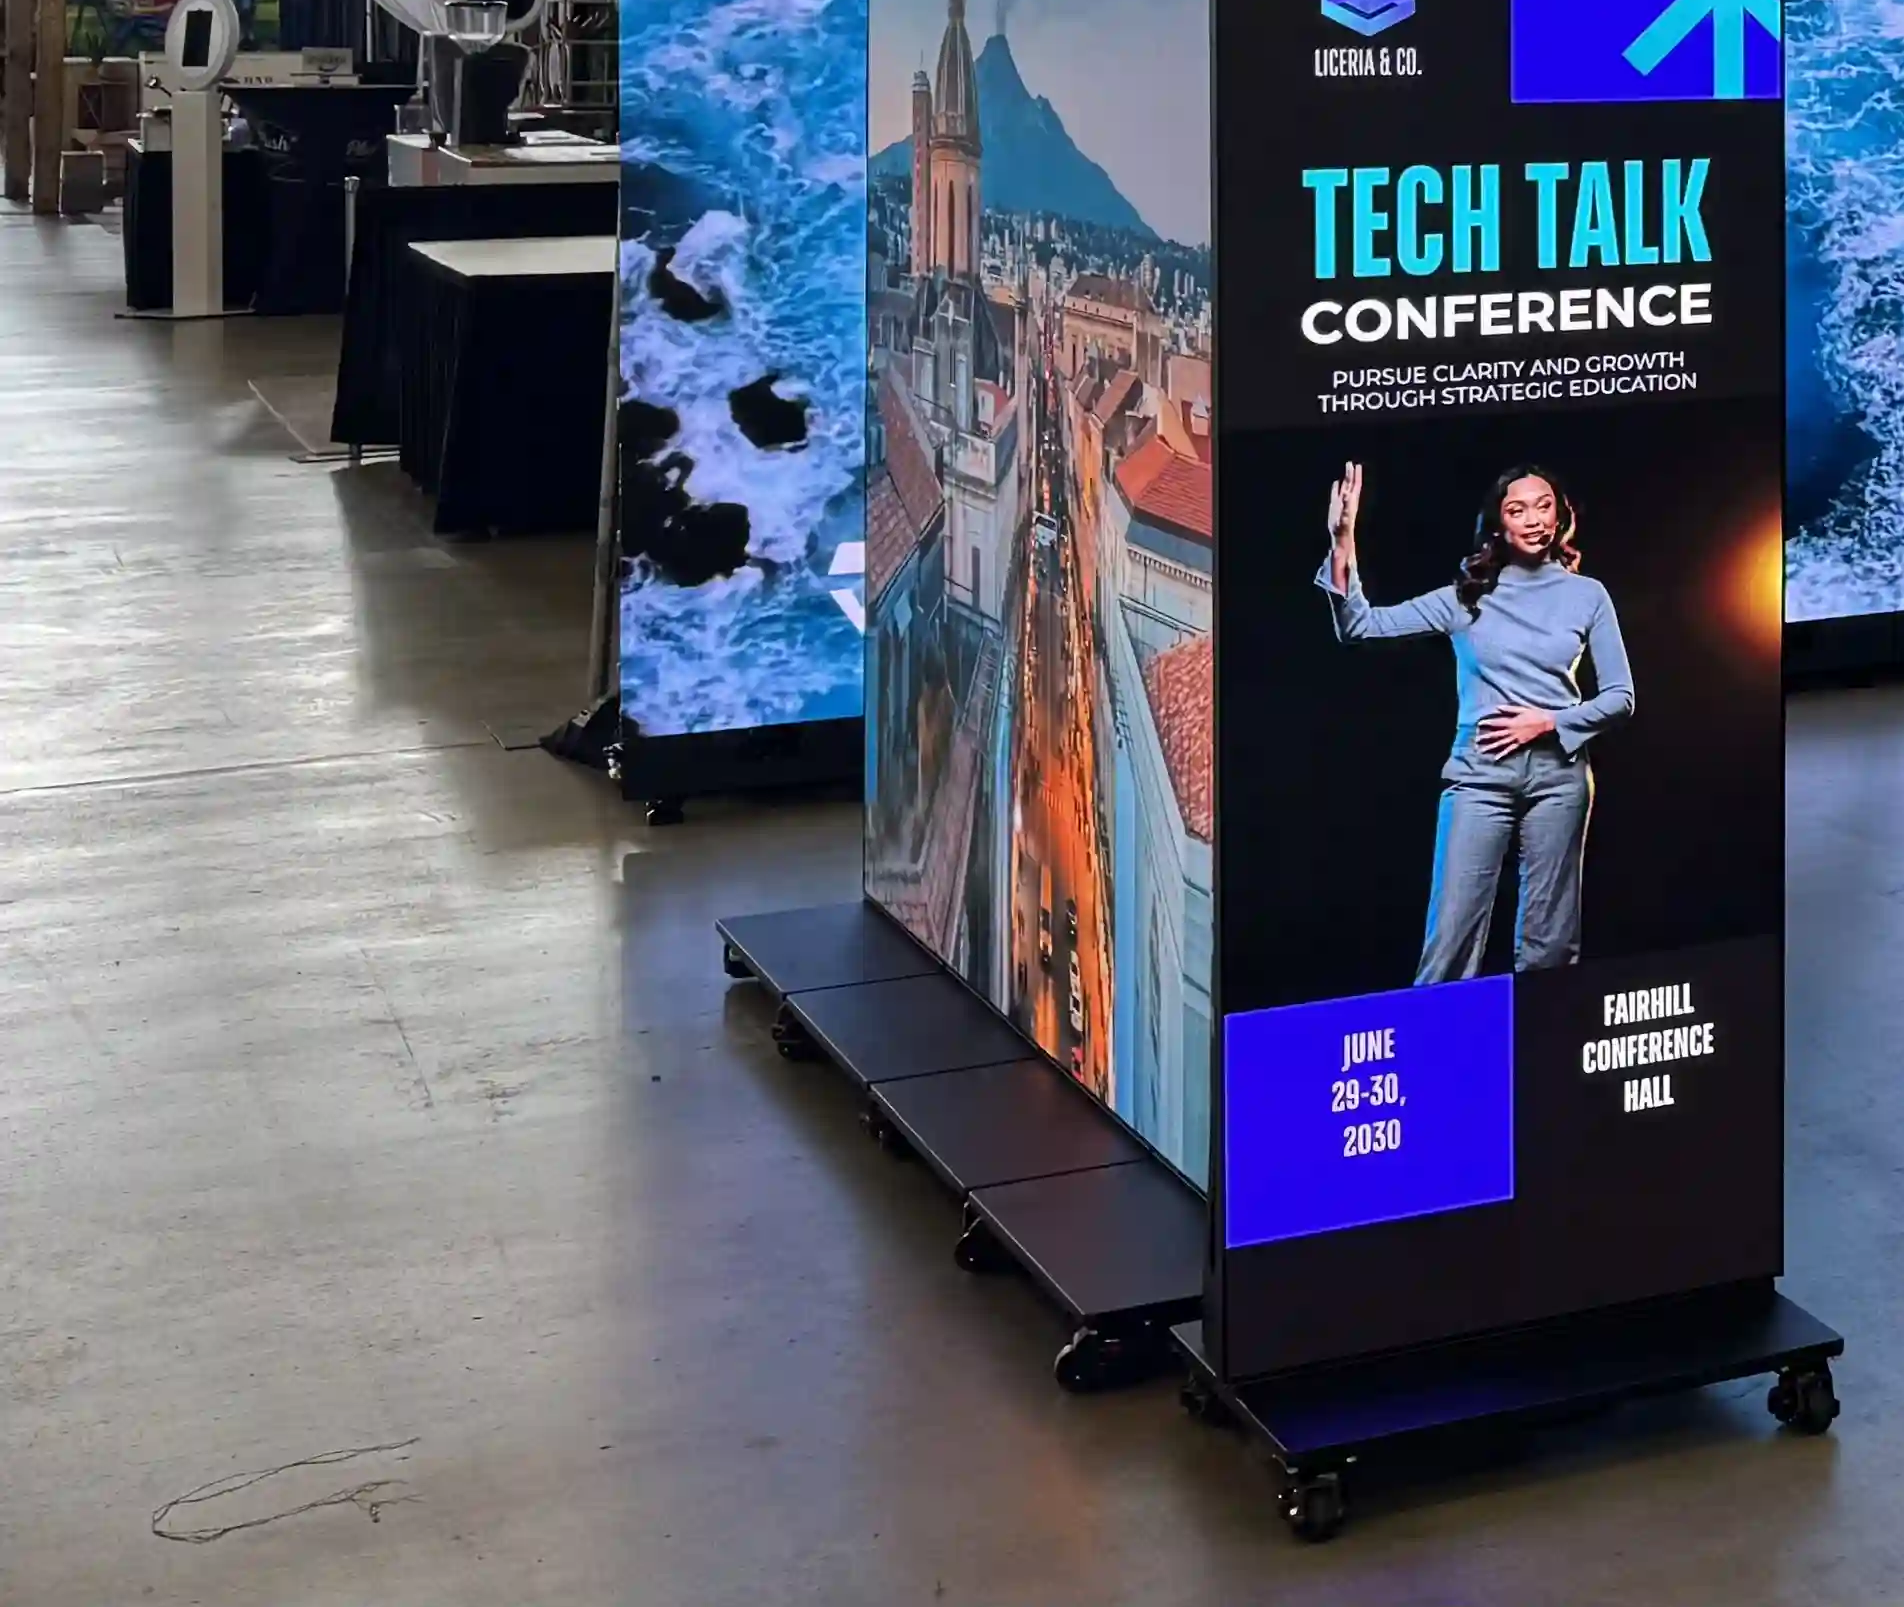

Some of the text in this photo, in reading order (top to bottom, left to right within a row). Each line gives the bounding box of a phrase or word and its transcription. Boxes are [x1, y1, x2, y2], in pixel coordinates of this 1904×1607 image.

[1314, 47, 1424, 78] LICERIA & CO.
[1302, 157, 1713, 279] TECH TALK
[1301, 283, 1713, 345] CONFERENCE
[1333, 351, 1685, 388] PURSUE CLARITY AND GROWTH
[1317, 371, 1698, 413] THROUGH STRATEGIC EDUCATION
[1603, 983, 1695, 1026] FAIRHILL
[1341, 1028, 1396, 1072] JUNE
[1582, 1022, 1715, 1074] CONFERENCE
[1331, 1072, 1406, 1113] 29-30,
[1623, 1074, 1675, 1113] HALL
[1343, 1118, 1402, 1157] 2030
